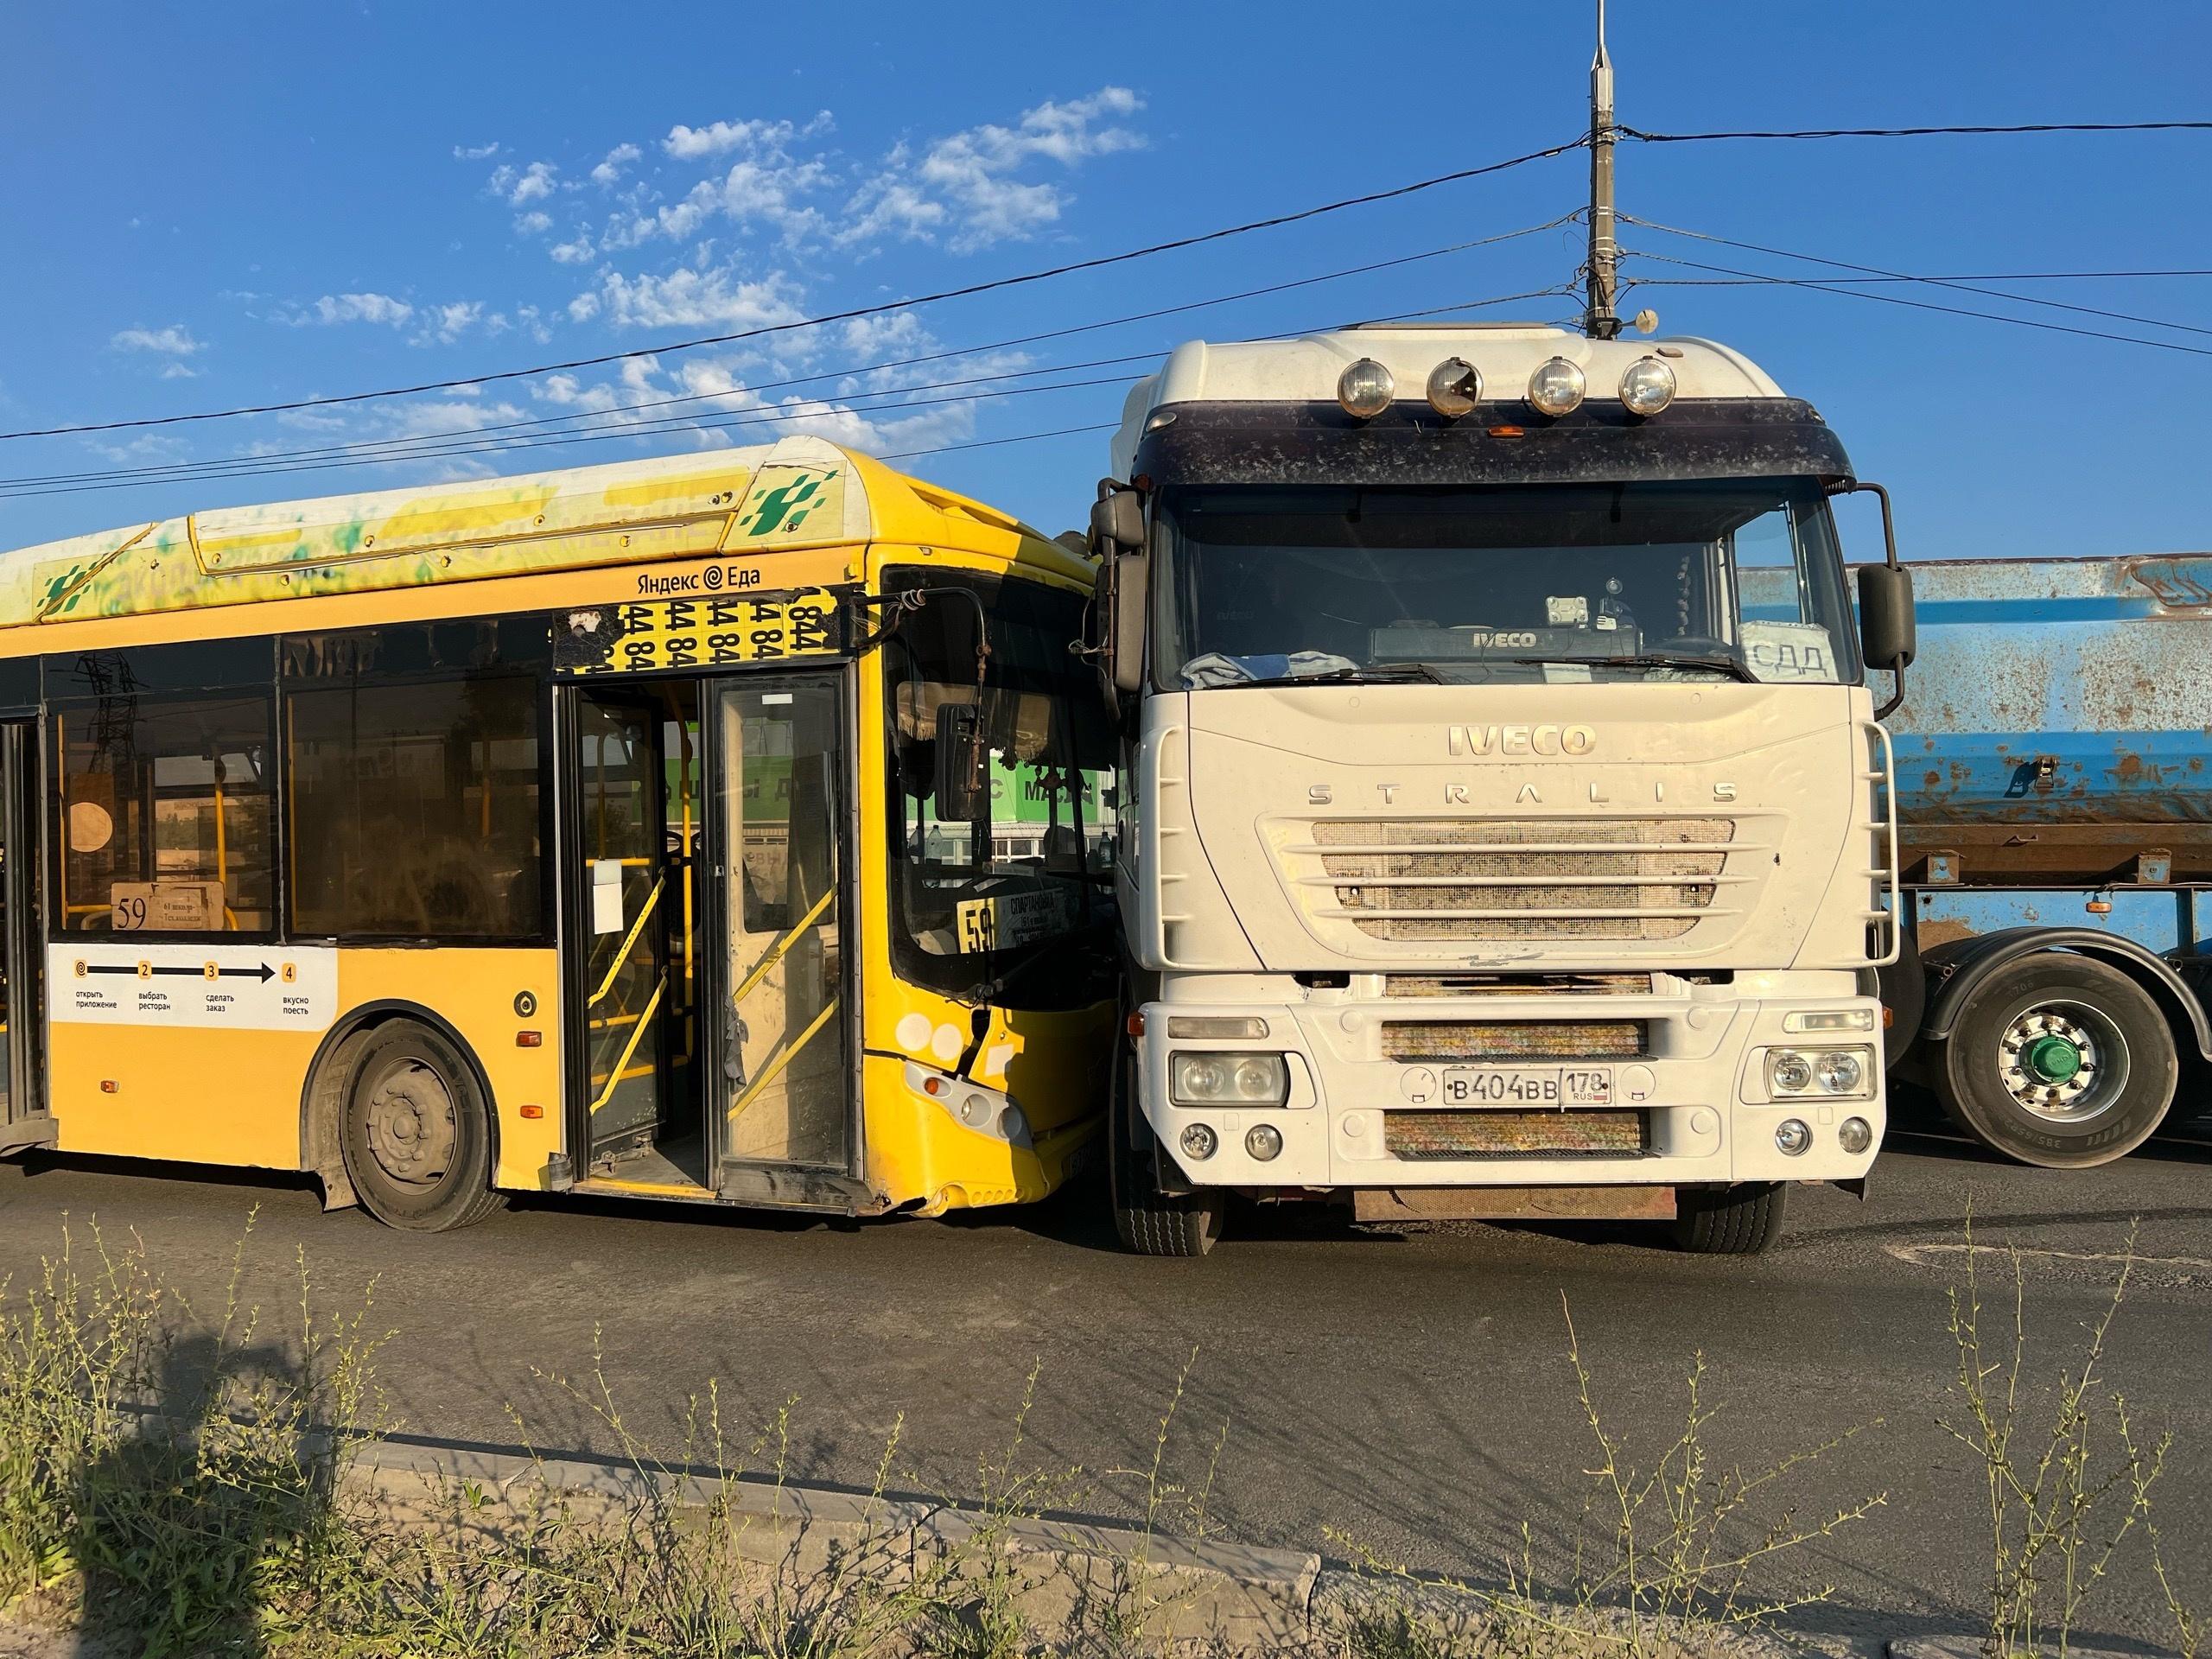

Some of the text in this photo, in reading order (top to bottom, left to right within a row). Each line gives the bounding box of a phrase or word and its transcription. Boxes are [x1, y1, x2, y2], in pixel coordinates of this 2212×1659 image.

[638, 566, 760, 595] Яндекс Еда
[1472, 632, 1537, 648] IVECO
[1448, 724, 1597, 756] IVECO
[1308, 781, 1738, 805] STRALIS
[118, 898, 146, 930] 59
[965, 907, 994, 953] 59
[142, 964, 293, 980] 2 3 4
[75, 990, 104, 999] открыть
[138, 991, 168, 1001] выбрать
[206, 995, 235, 1003] сделать
[283, 996, 309, 1006] вкусно
[75, 1001, 118, 1009] приложение
[206, 1004, 226, 1013] заказ
[283, 1007, 309, 1015] поесть
[1453, 1072, 1605, 1100] В404ВВ 178
[1573, 1092, 1593, 1101] RUS
